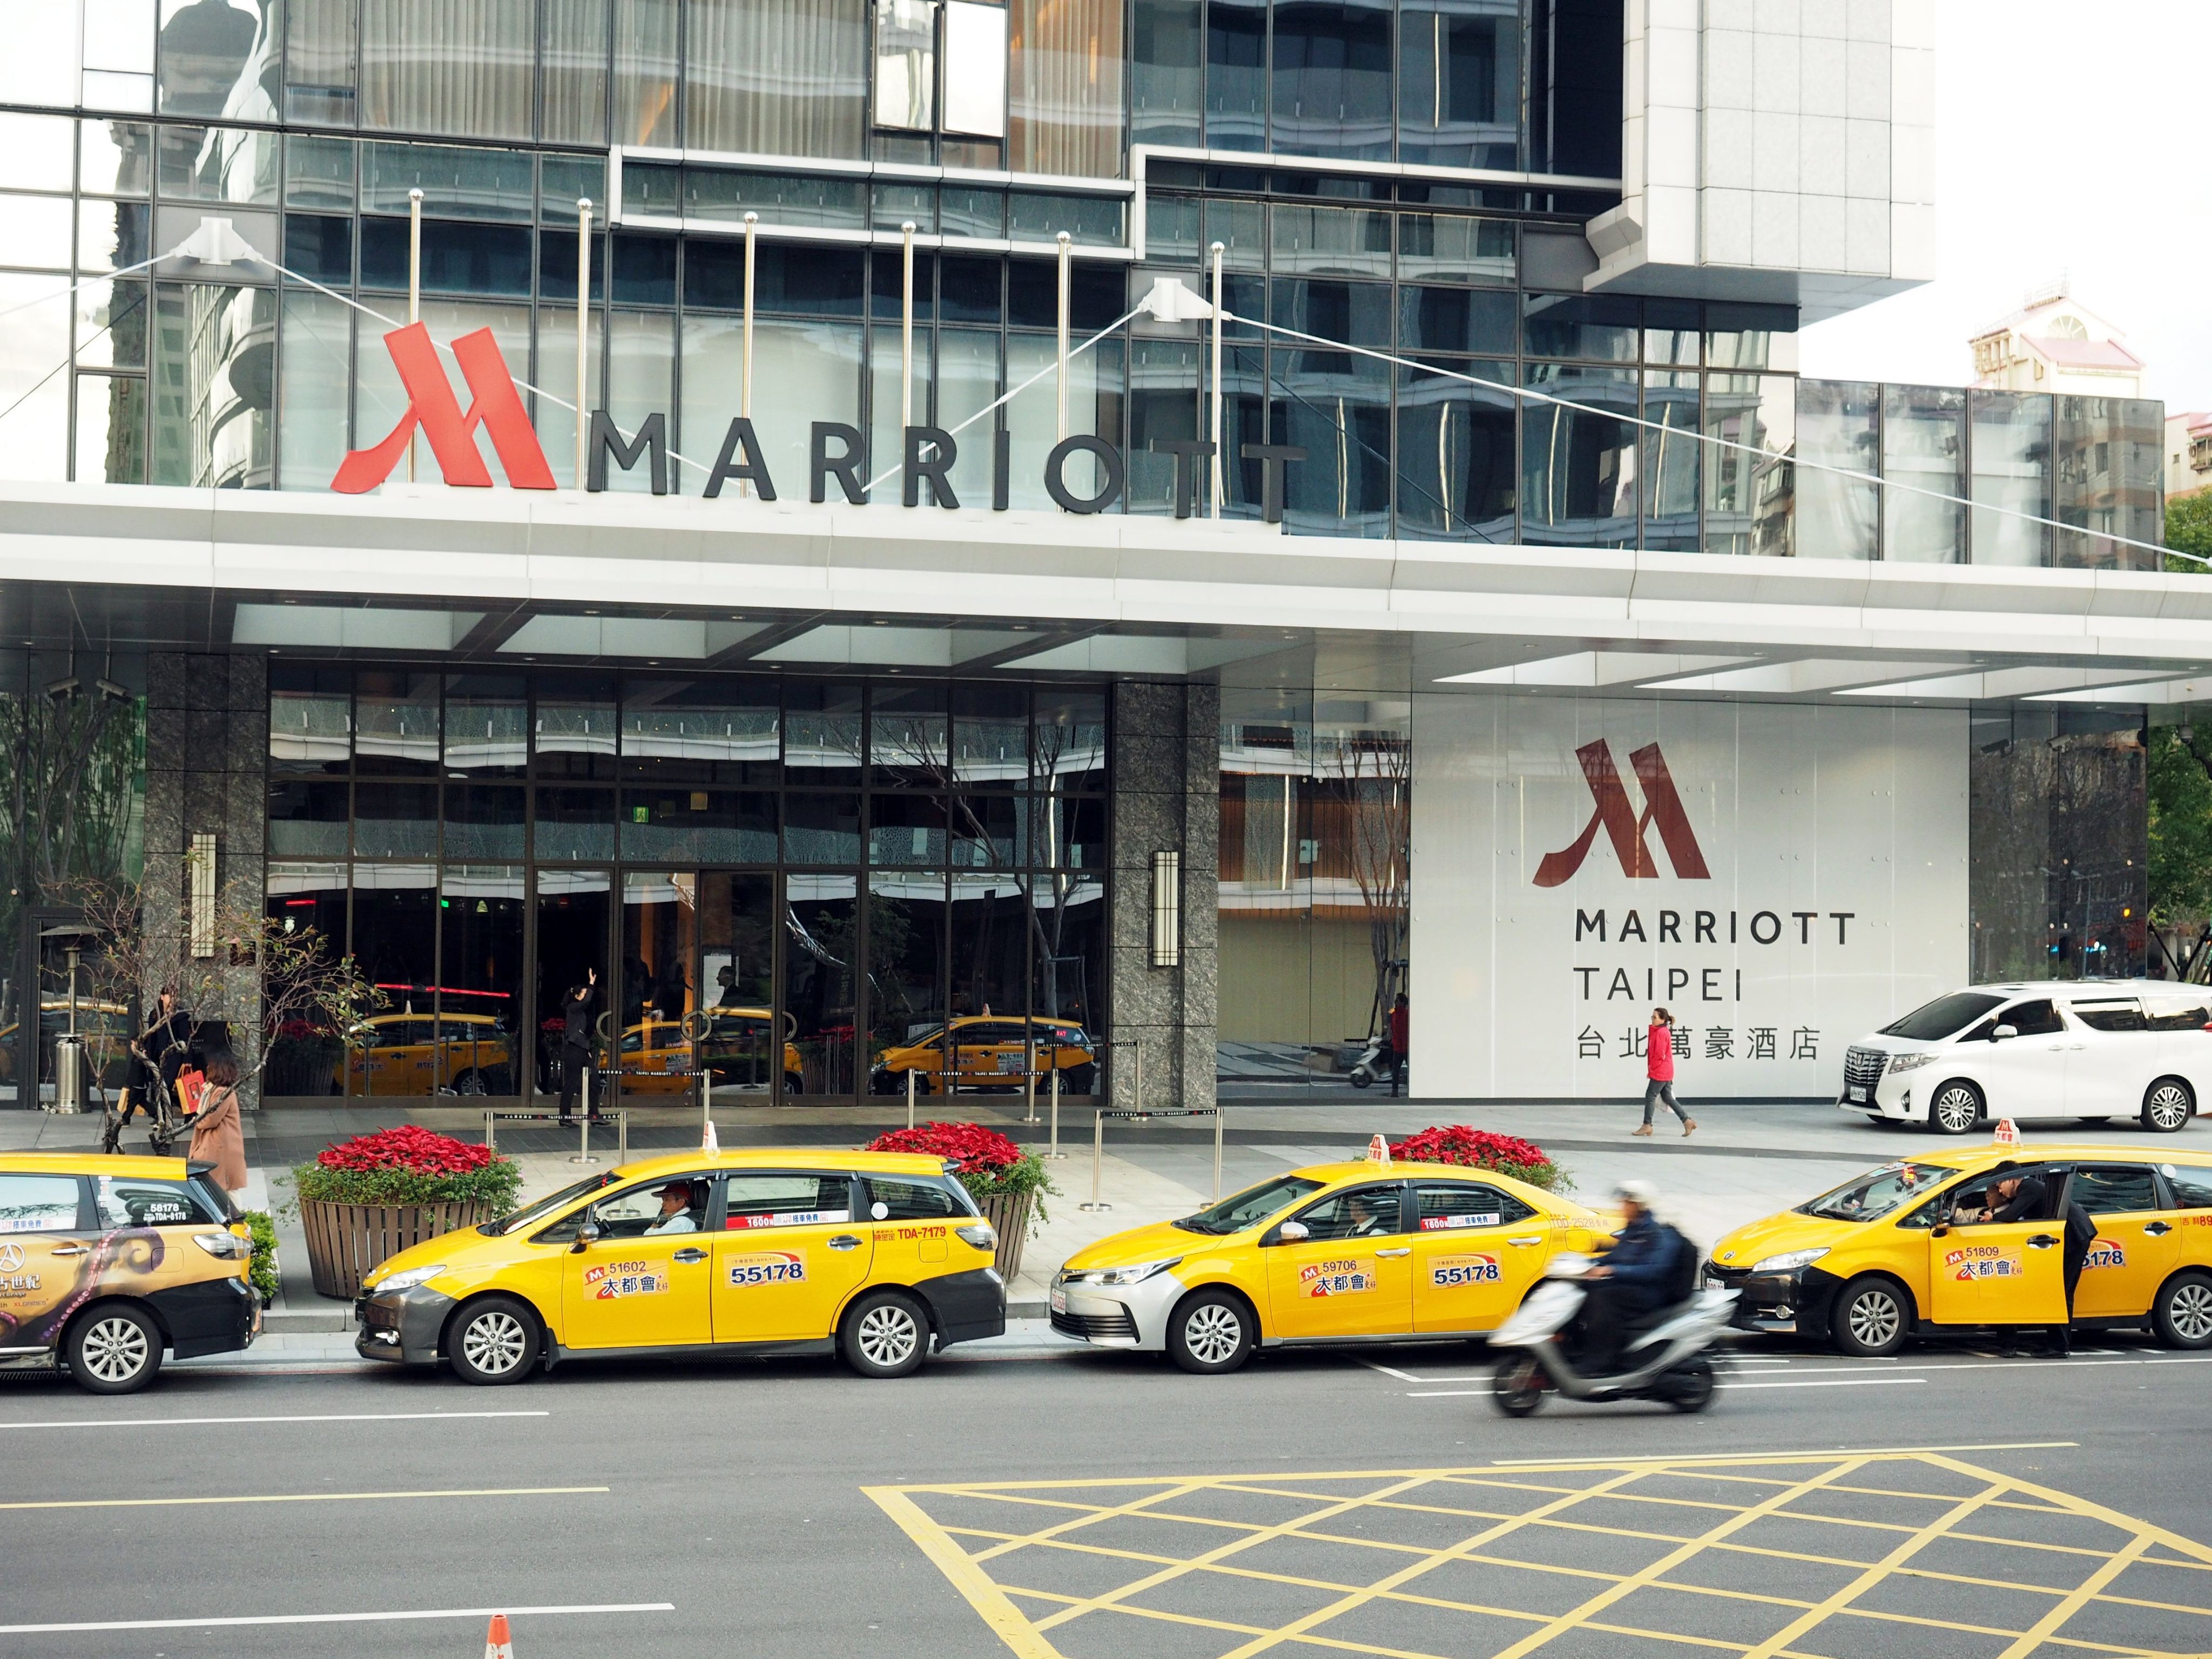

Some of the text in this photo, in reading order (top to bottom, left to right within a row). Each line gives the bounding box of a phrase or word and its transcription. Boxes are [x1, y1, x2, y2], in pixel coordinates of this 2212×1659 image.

[587, 410, 1307, 523] MARRIOTT
[1575, 909, 1855, 945] MARRIOTT
[1573, 967, 1741, 1001] TAIPEI
[1577, 1025, 1820, 1061] 台北萬豪酒店
[154, 1211, 186, 1221] TDA-8178
[793, 1213, 818, 1223] 搭車免費
[1465, 1216, 1488, 1224] 搭車免費
[898, 1226, 946, 1239] TDA-7179
[1966, 1246, 1999, 1257] 51809
[610, 1261, 646, 1273] 51602
[731, 1263, 803, 1284] 55178
[1323, 1260, 1357, 1272] 59706
[1434, 1264, 1499, 1284] 55178
[1961, 1260, 2010, 1276] 大都會
[602, 1275, 656, 1294] 大都會
[1316, 1273, 1365, 1292] 大都會
